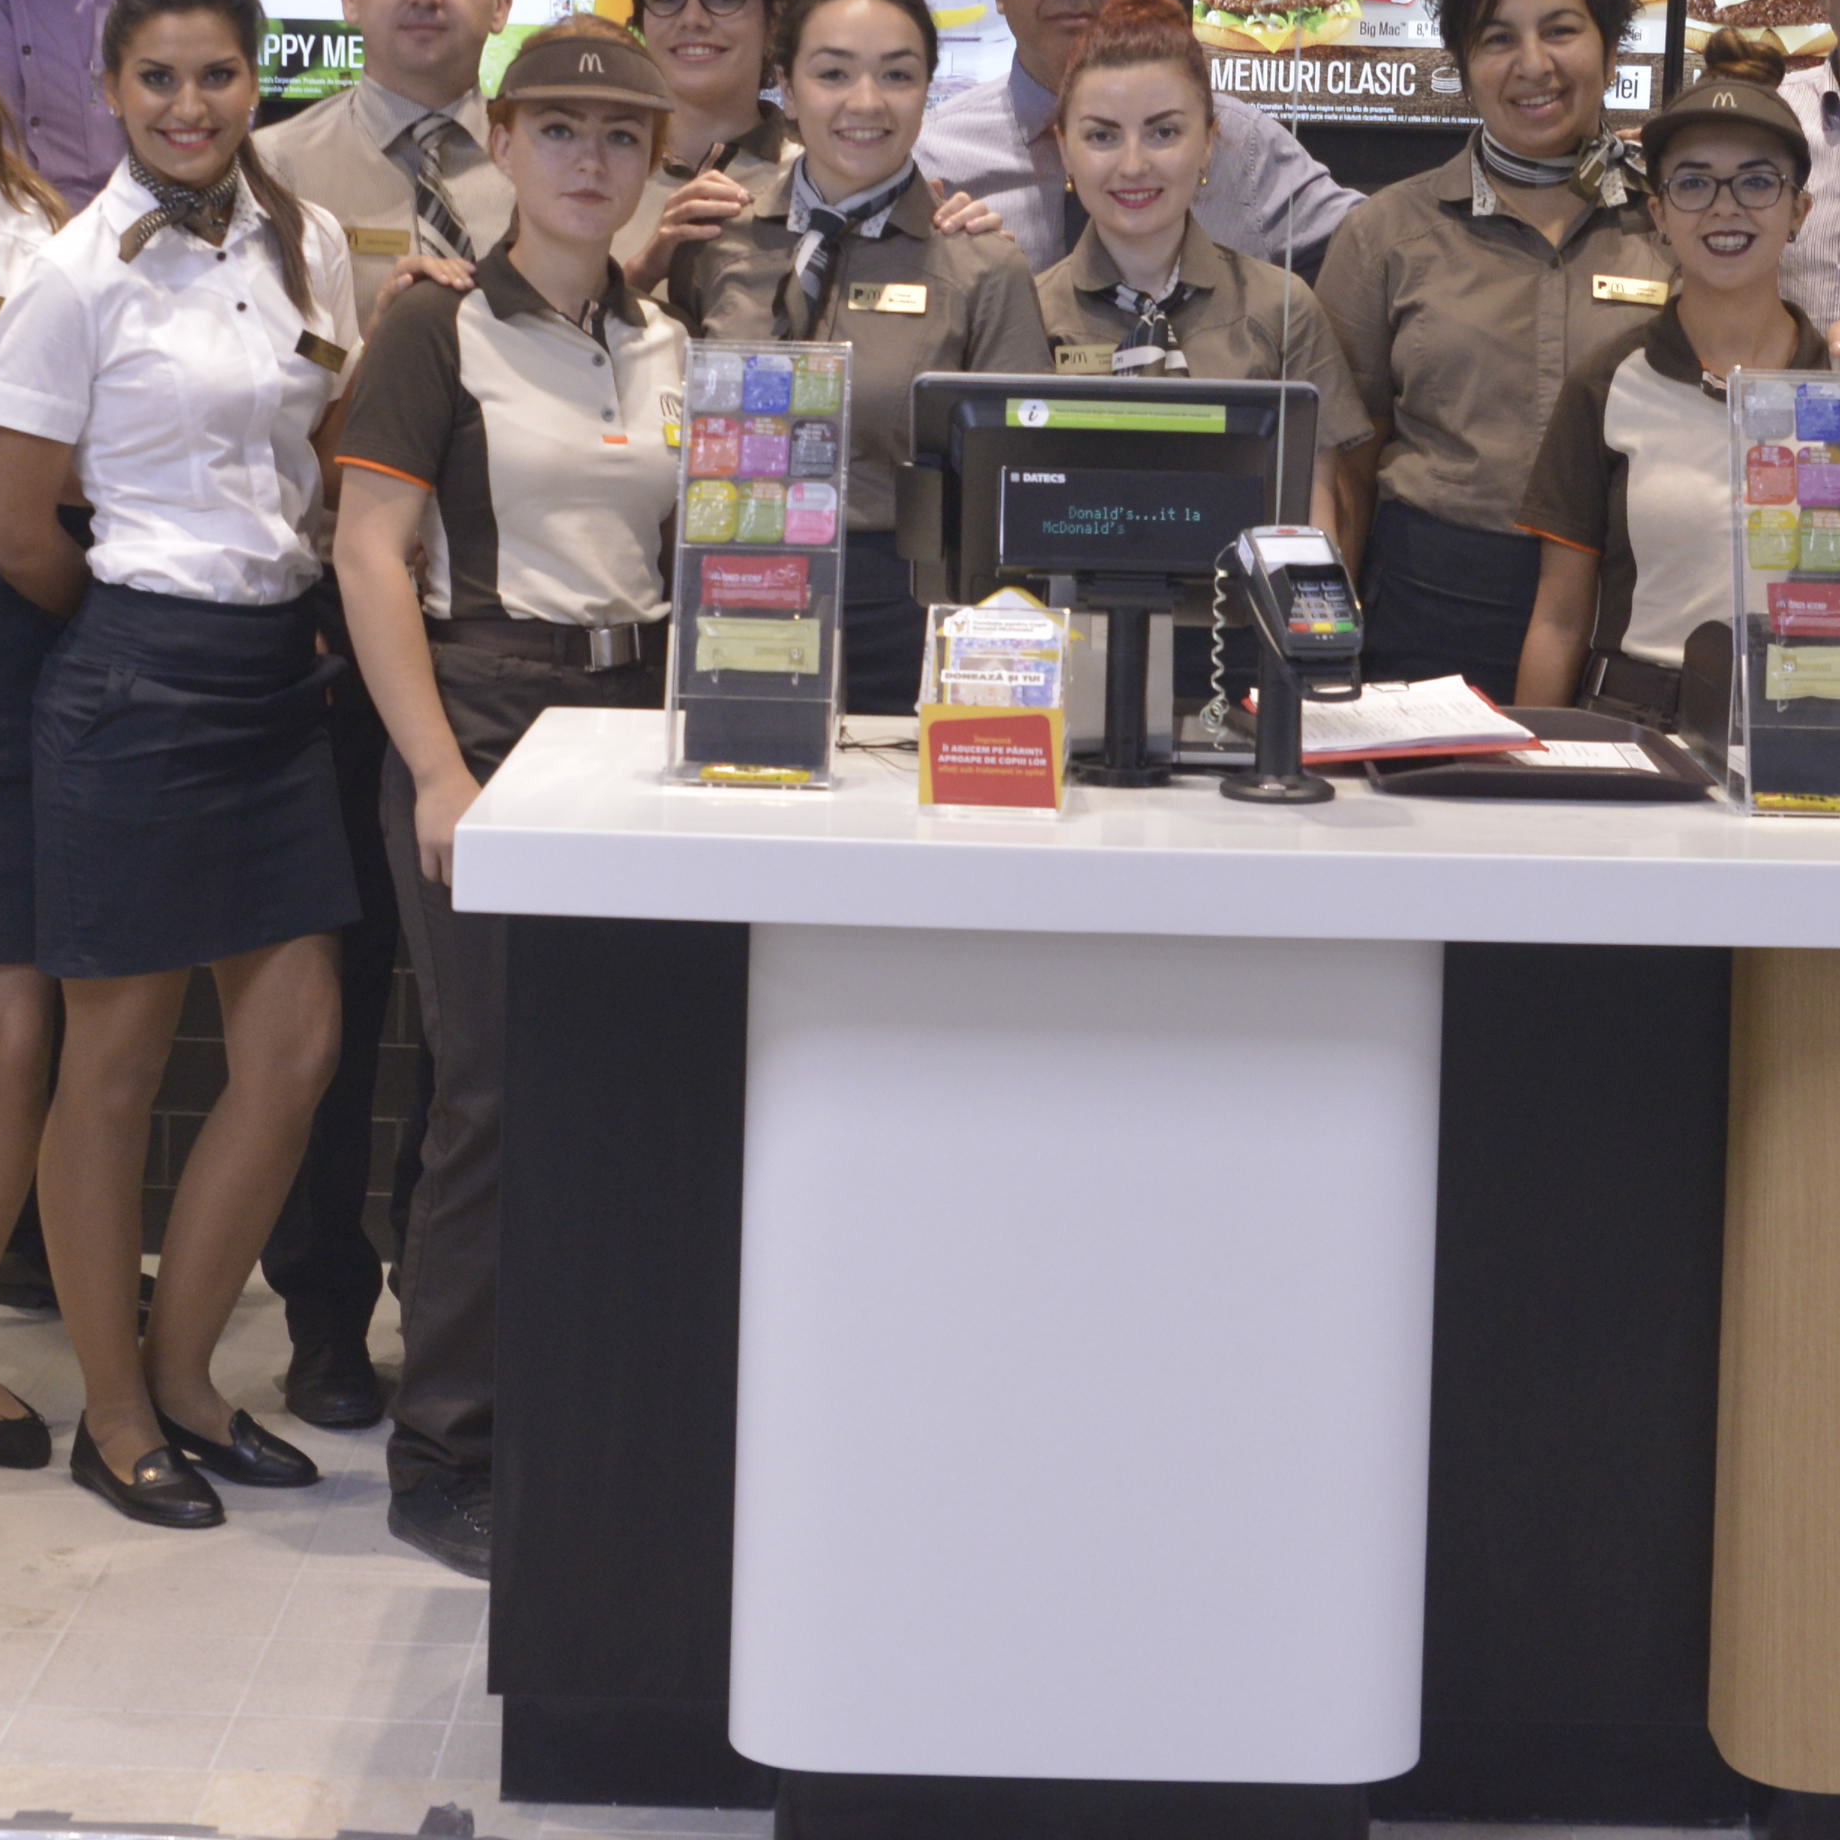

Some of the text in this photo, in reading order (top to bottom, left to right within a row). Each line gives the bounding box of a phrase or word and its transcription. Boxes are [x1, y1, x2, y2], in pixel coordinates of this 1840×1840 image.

[1360, 21, 1376, 38] Big
[1211, 58, 1639, 99] MENIURI CLASIC lei
[1022, 473, 1066, 483] DATECS
[1185, 508, 1201, 521] la
[992, 746, 1004, 754] PE
[938, 755, 982, 763] APROAPE
[984, 756, 996, 764] DE
[1028, 758, 1046, 766] LOR
